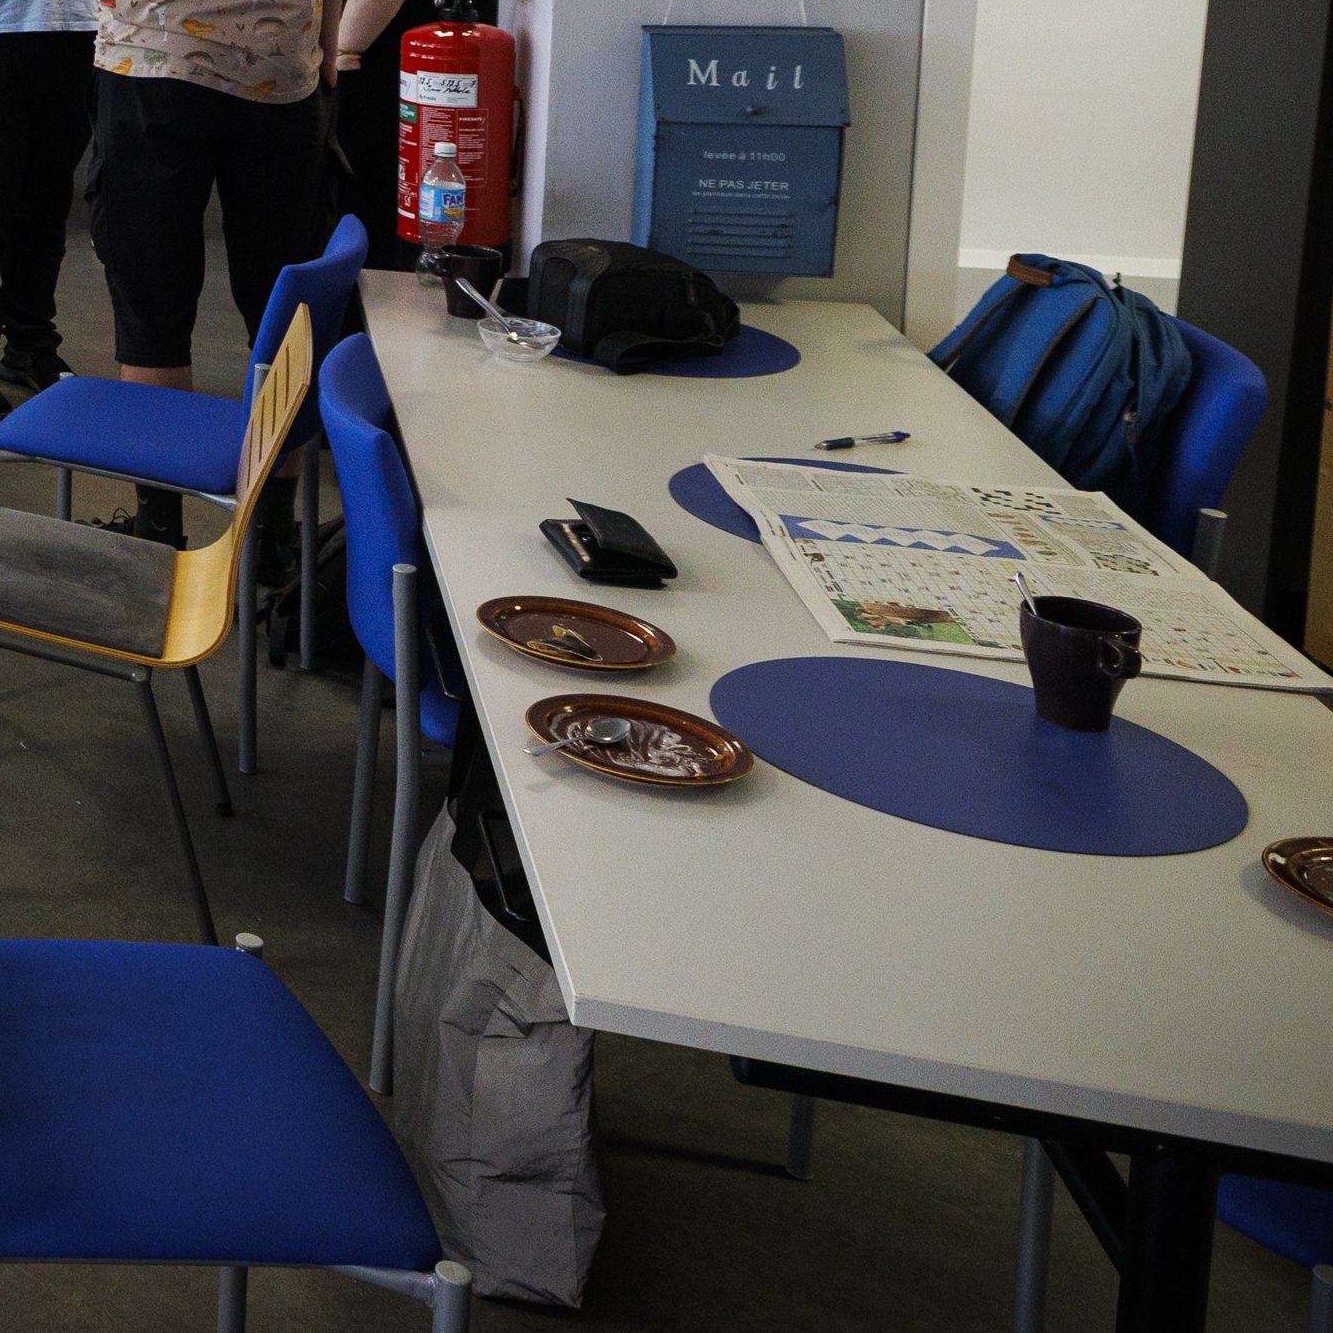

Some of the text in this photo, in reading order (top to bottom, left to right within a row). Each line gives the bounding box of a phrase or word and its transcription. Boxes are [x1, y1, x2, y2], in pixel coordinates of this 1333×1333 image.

[686, 58, 804, 90] Mail
[698, 179, 790, 191] NE PAS JETER
